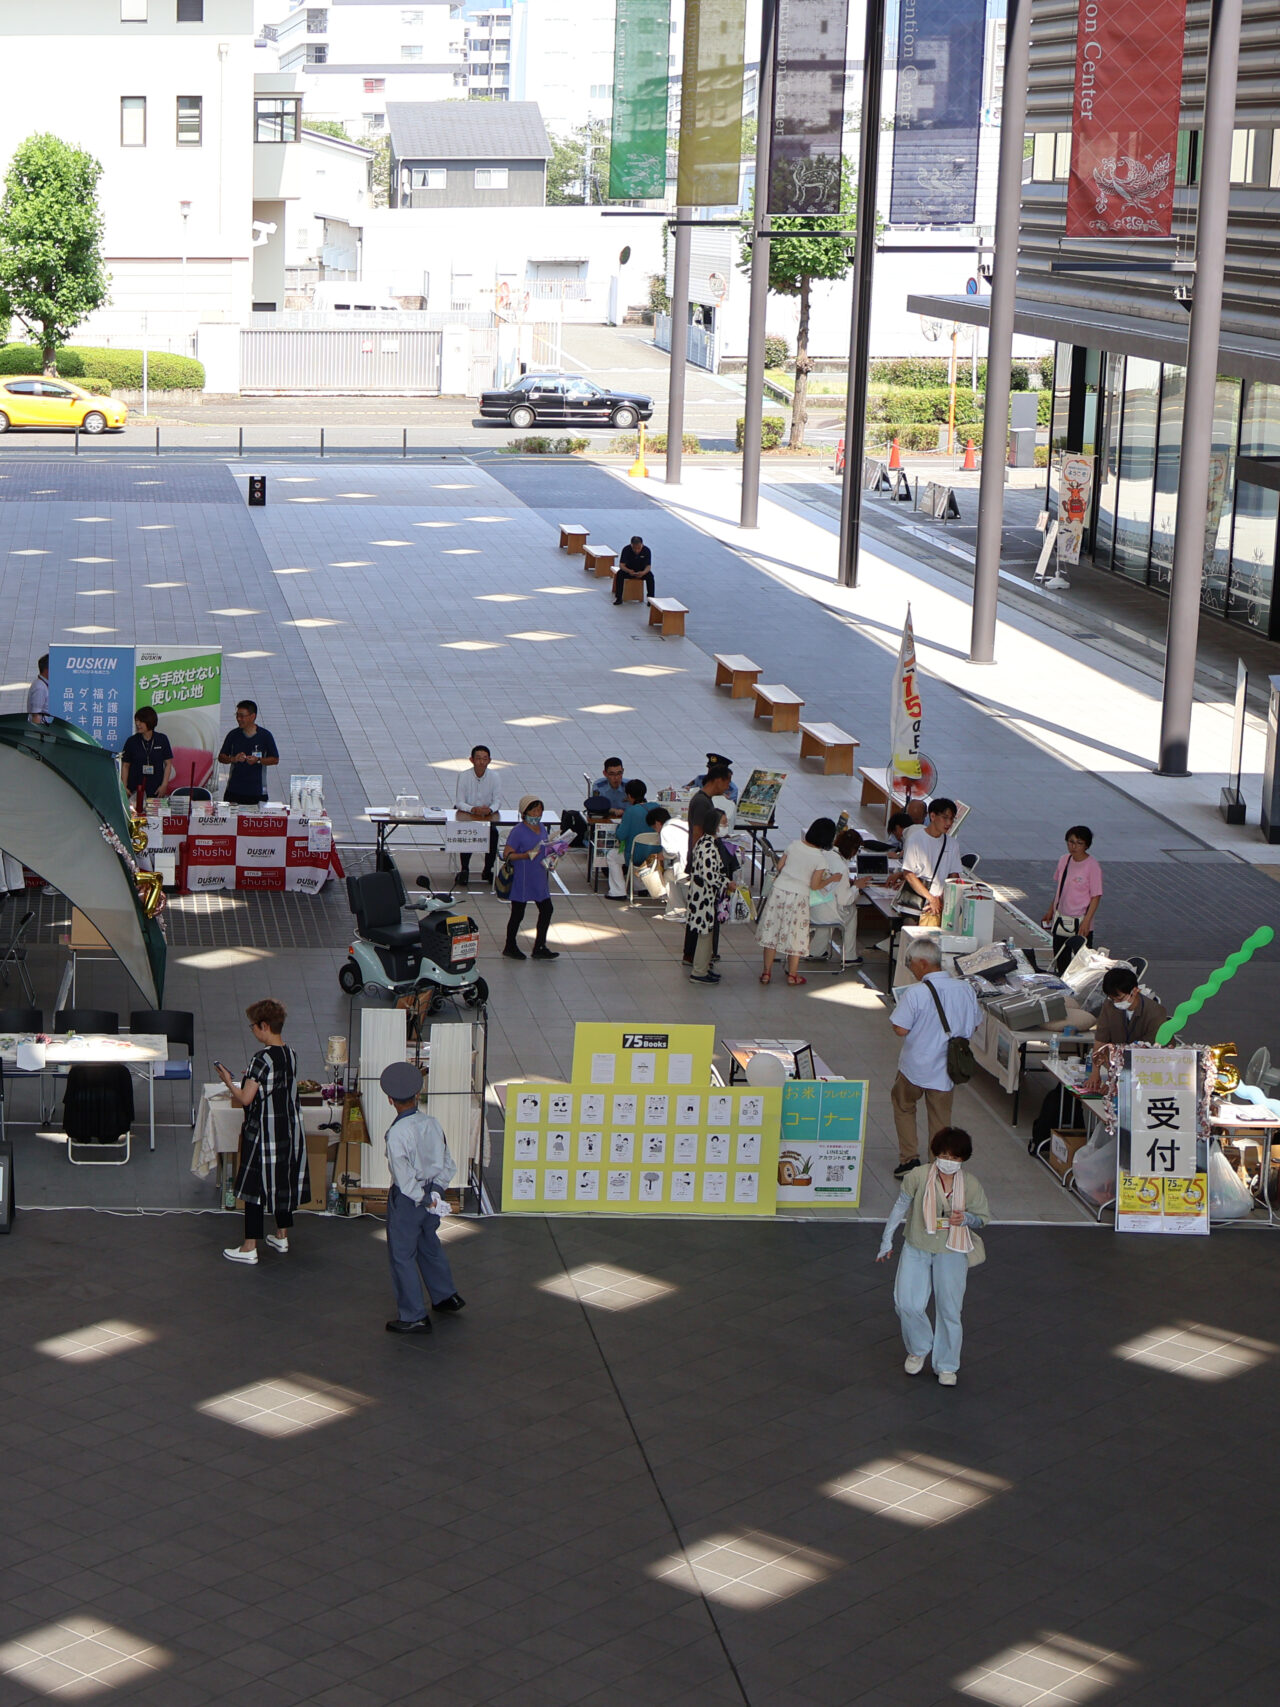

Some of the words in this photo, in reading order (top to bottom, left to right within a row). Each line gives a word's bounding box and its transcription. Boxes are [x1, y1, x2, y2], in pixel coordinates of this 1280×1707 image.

[1084, 0, 1099, 33] on
[1080, 41, 1102, 121] Center
[900, 65, 918, 129] Center
[775, 82, 790, 136] Center
[65, 657, 118, 670] DUSKIN
[138, 666, 221, 690] もう手放せない
[151, 684, 205, 706] 使い心地
[242, 818, 284, 828] shushu
[192, 848, 232, 857] shushu
[247, 848, 276, 856] DUSKIN
[197, 877, 226, 885] DUSKIN
[241, 877, 282, 886] shushu
[624, 1034, 643, 1048] 75
[785, 1086, 816, 1099] お米
[824, 1089, 860, 1098] プレゼント
[1146, 1096, 1180, 1172] 受付
